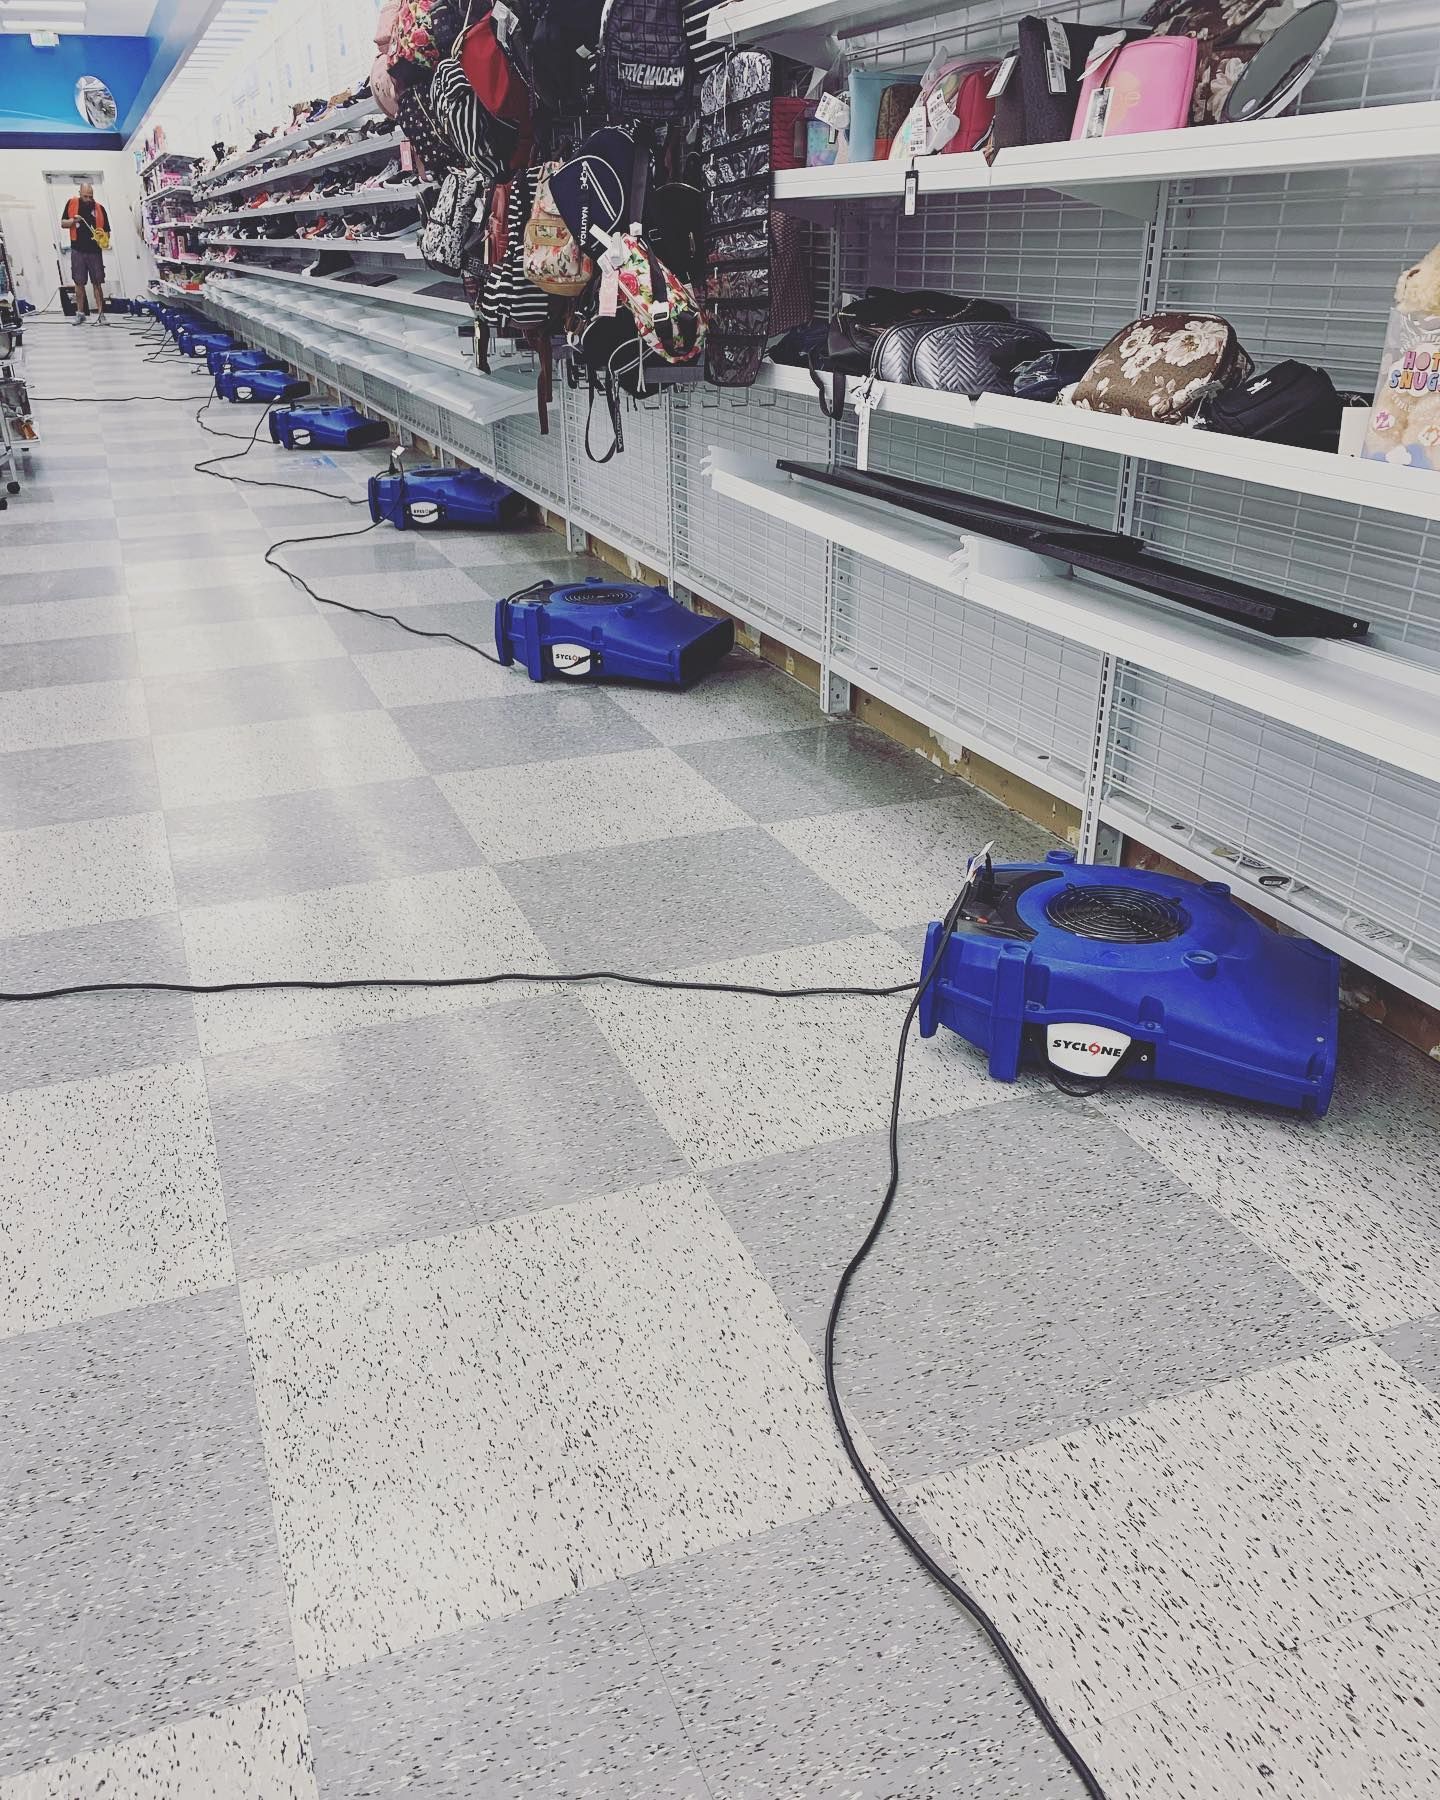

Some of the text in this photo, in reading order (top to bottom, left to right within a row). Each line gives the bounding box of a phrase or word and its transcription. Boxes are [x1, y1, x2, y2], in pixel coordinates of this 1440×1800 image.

[618, 62, 685, 87] TEVE MADDEN
[580, 206, 589, 246] NAUTICA
[1403, 350, 1440, 373] HOT
[1390, 369, 1440, 392] SNUG
[1052, 1039, 1122, 1057] SYCLONE
